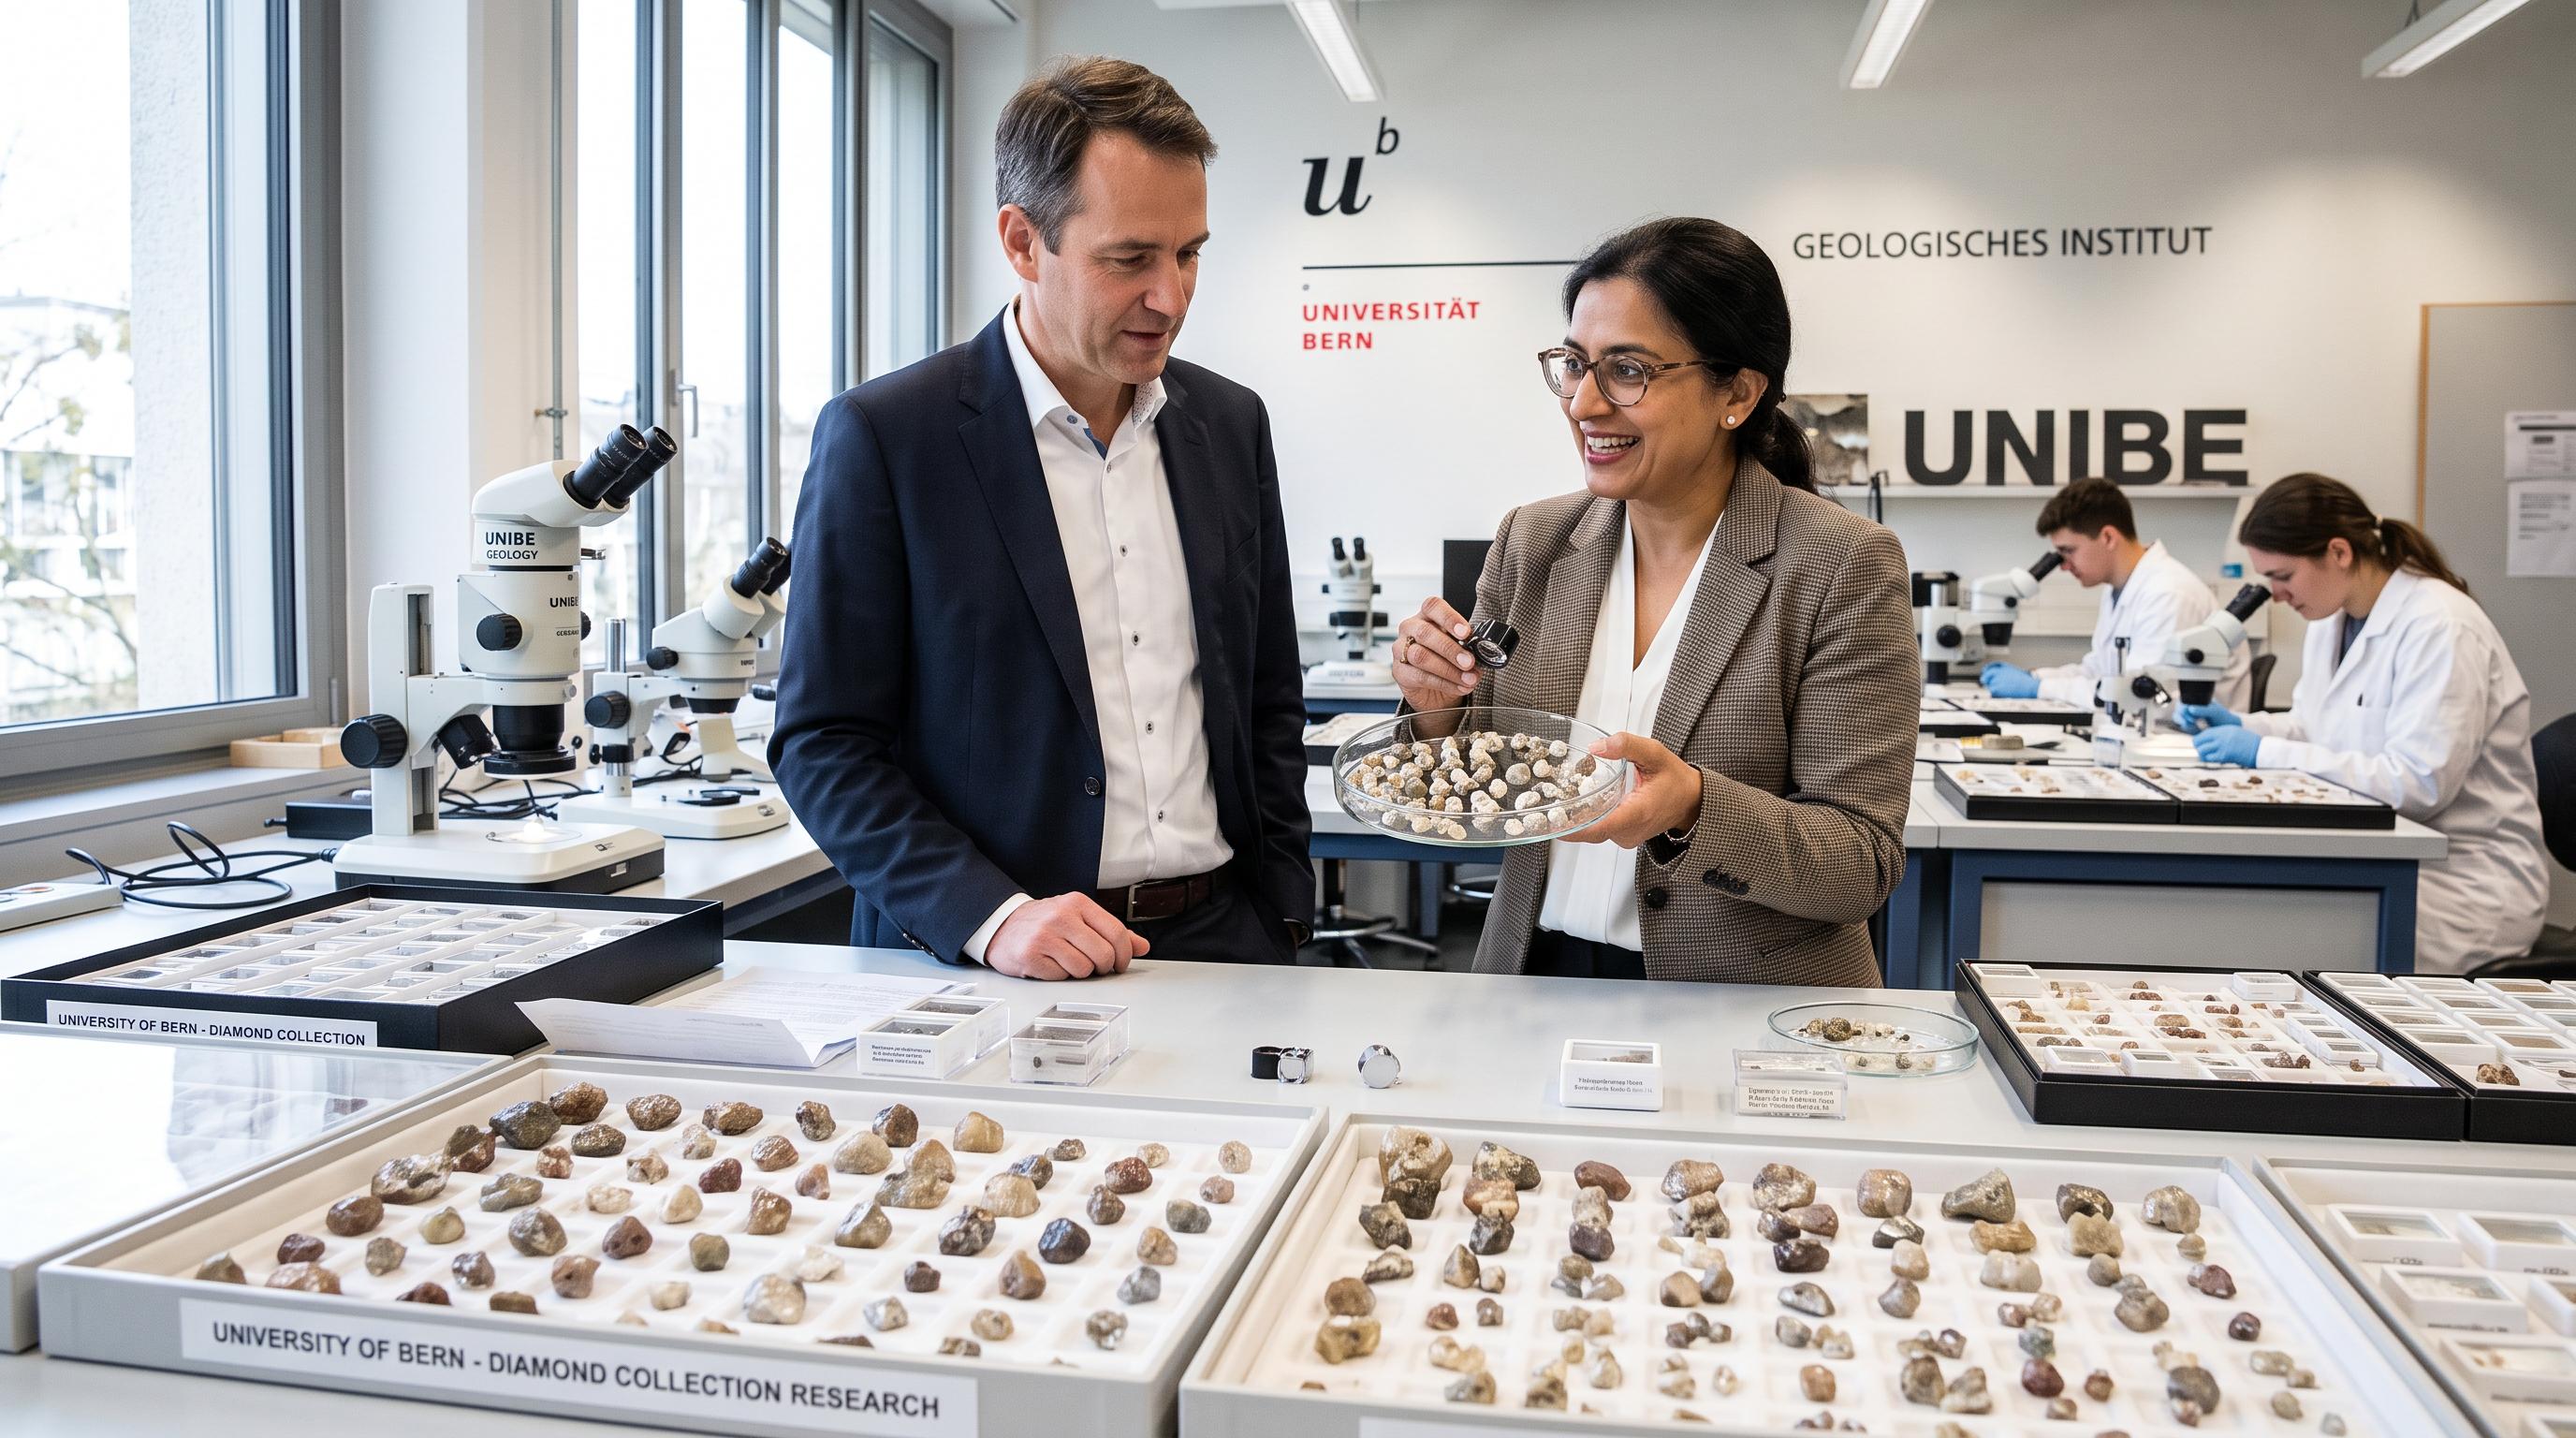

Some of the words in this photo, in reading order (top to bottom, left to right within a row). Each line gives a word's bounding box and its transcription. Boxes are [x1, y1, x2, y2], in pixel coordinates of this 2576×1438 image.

[1793, 227, 2050, 259] GEOLOGISCHES
[2061, 227, 2213, 257] INSTITUT
[1302, 297, 1481, 322] UNIVERSITÄT
[1302, 331, 1374, 350] BERN
[1904, 408, 2248, 487] UNIBE
[485, 532, 535, 546] UNIBE
[486, 550, 539, 561] GEOLOGY
[58, 1014, 137, 1030] UNIVERSITY
[139, 1019, 157, 1032] OF
[160, 1020, 198, 1034] BERN
[209, 1024, 273, 1040] DIAMOND
[276, 1029, 365, 1047] COLLECTION
[212, 1321, 351, 1357] UNIVERSITY
[358, 1338, 390, 1360] OF
[398, 1342, 464, 1370] BERN
[489, 1352, 607, 1385] DIAMOND
[614, 1365, 782, 1403] COLLECTION
[791, 1383, 940, 1419] RESEARCH
